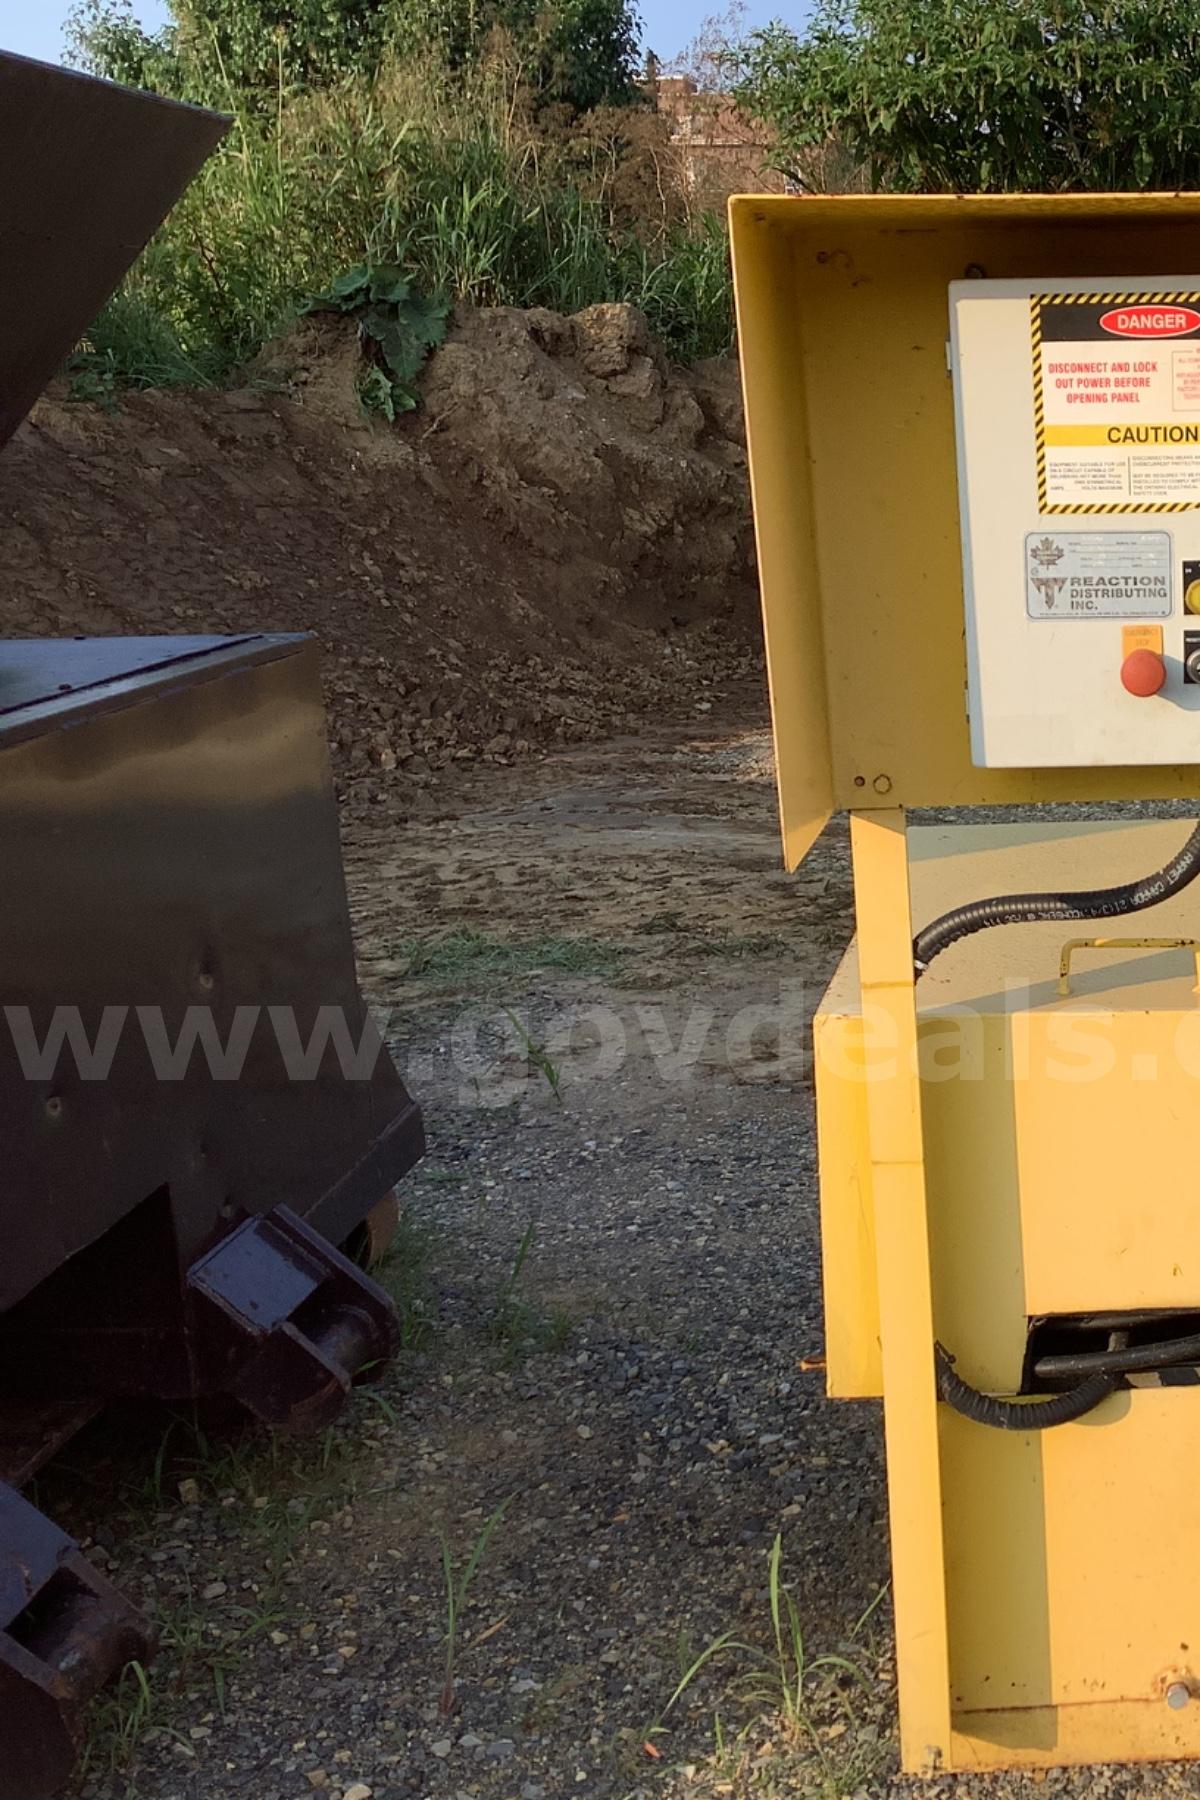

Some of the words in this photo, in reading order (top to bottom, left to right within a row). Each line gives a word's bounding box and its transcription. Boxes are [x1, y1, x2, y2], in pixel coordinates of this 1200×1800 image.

[1116, 314, 1187, 329] DANGER
[1048, 362, 1108, 374] DISCONNECT
[1111, 362, 1130, 373] AND
[1133, 361, 1158, 372] LOCK
[1055, 378, 1074, 389] OUT
[1076, 378, 1111, 388] POWER
[1114, 377, 1152, 388] BEFORE
[1066, 393, 1108, 404] OPENING
[1110, 392, 1140, 403] PANEL
[1106, 425, 1200, 444] CAUTION
[1070, 576, 1166, 587] REACTION
[1070, 588, 1168, 598] DISTRIBUTING
[1070, 600, 1098, 610] INC.
